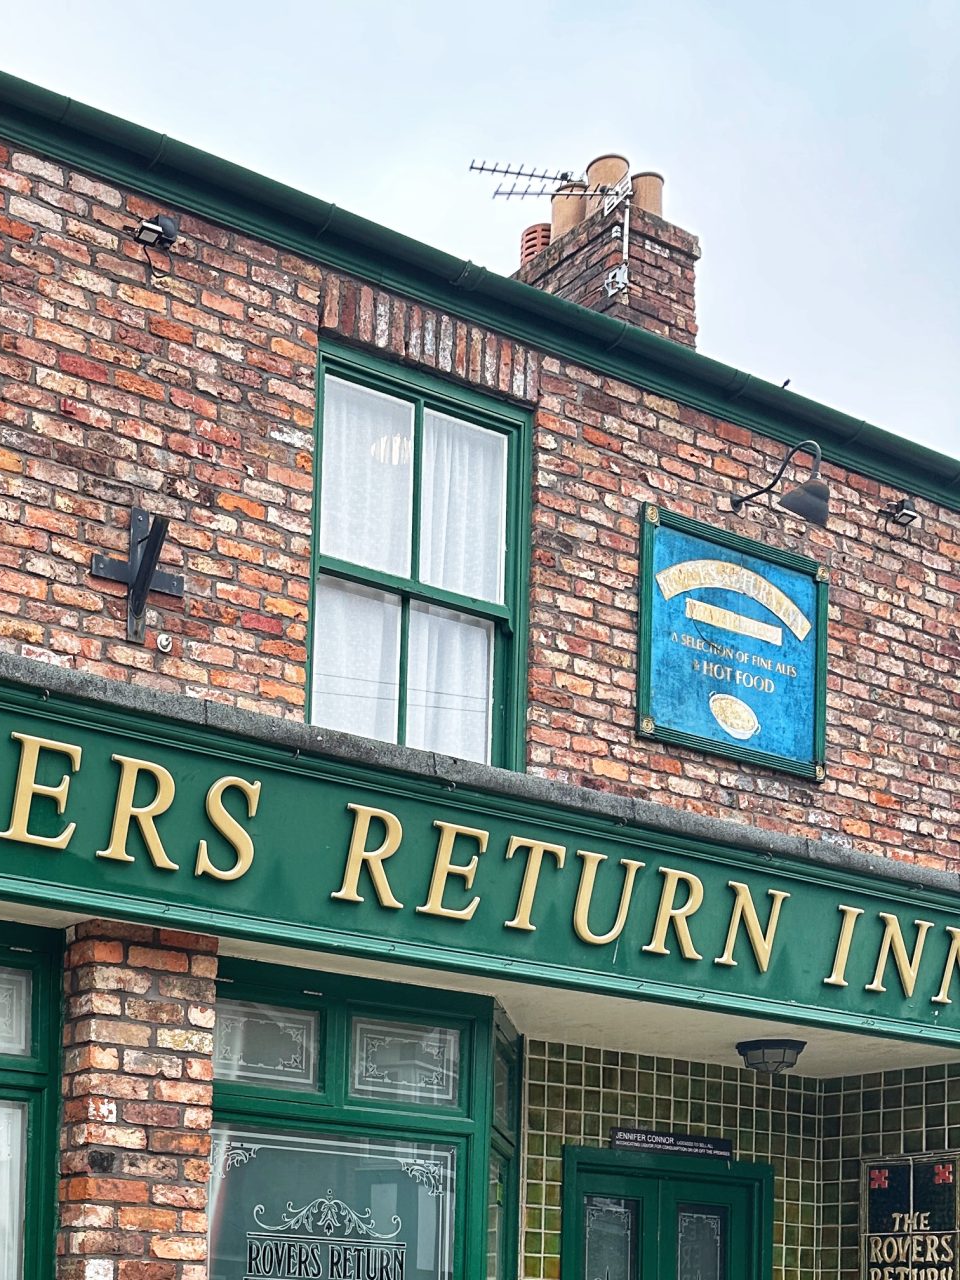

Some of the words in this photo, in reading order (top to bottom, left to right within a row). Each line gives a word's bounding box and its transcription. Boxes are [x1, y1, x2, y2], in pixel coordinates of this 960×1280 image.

[671, 631, 678, 643] A
[681, 633, 734, 660] SELECTION
[736, 651, 749, 664] OF
[752, 655, 773, 671] FINE
[775, 662, 797, 678] ALES
[702, 660, 732, 682] HOT
[735, 670, 775, 693] FOOD
[331, 802, 791, 973] RETURN
[615, 1131, 646, 1141] JENNIFER
[647, 1135, 674, 1144] CONNOR
[891, 1211, 931, 1232] THE
[246, 1239, 322, 1279] ROVERS
[869, 1234, 954, 1264] ROVERS
